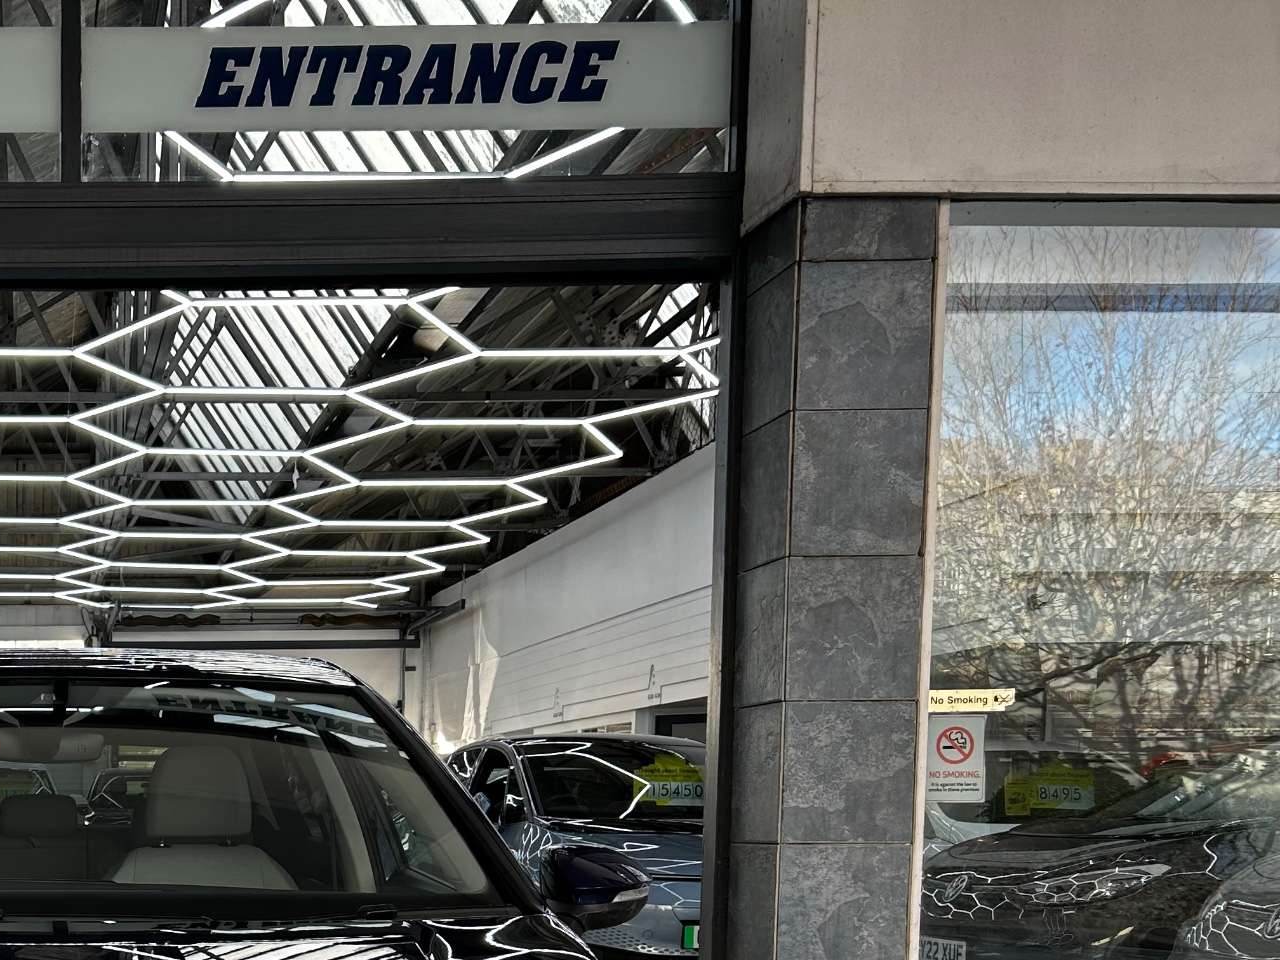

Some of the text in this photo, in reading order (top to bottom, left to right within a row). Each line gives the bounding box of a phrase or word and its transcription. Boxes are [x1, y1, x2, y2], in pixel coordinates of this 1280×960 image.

[194, 40, 620, 108] ENTRANCE
[930, 695, 988, 705] No Smoking
[928, 770, 980, 779] NO SMOKING
[1039, 787, 1081, 801] 8495
